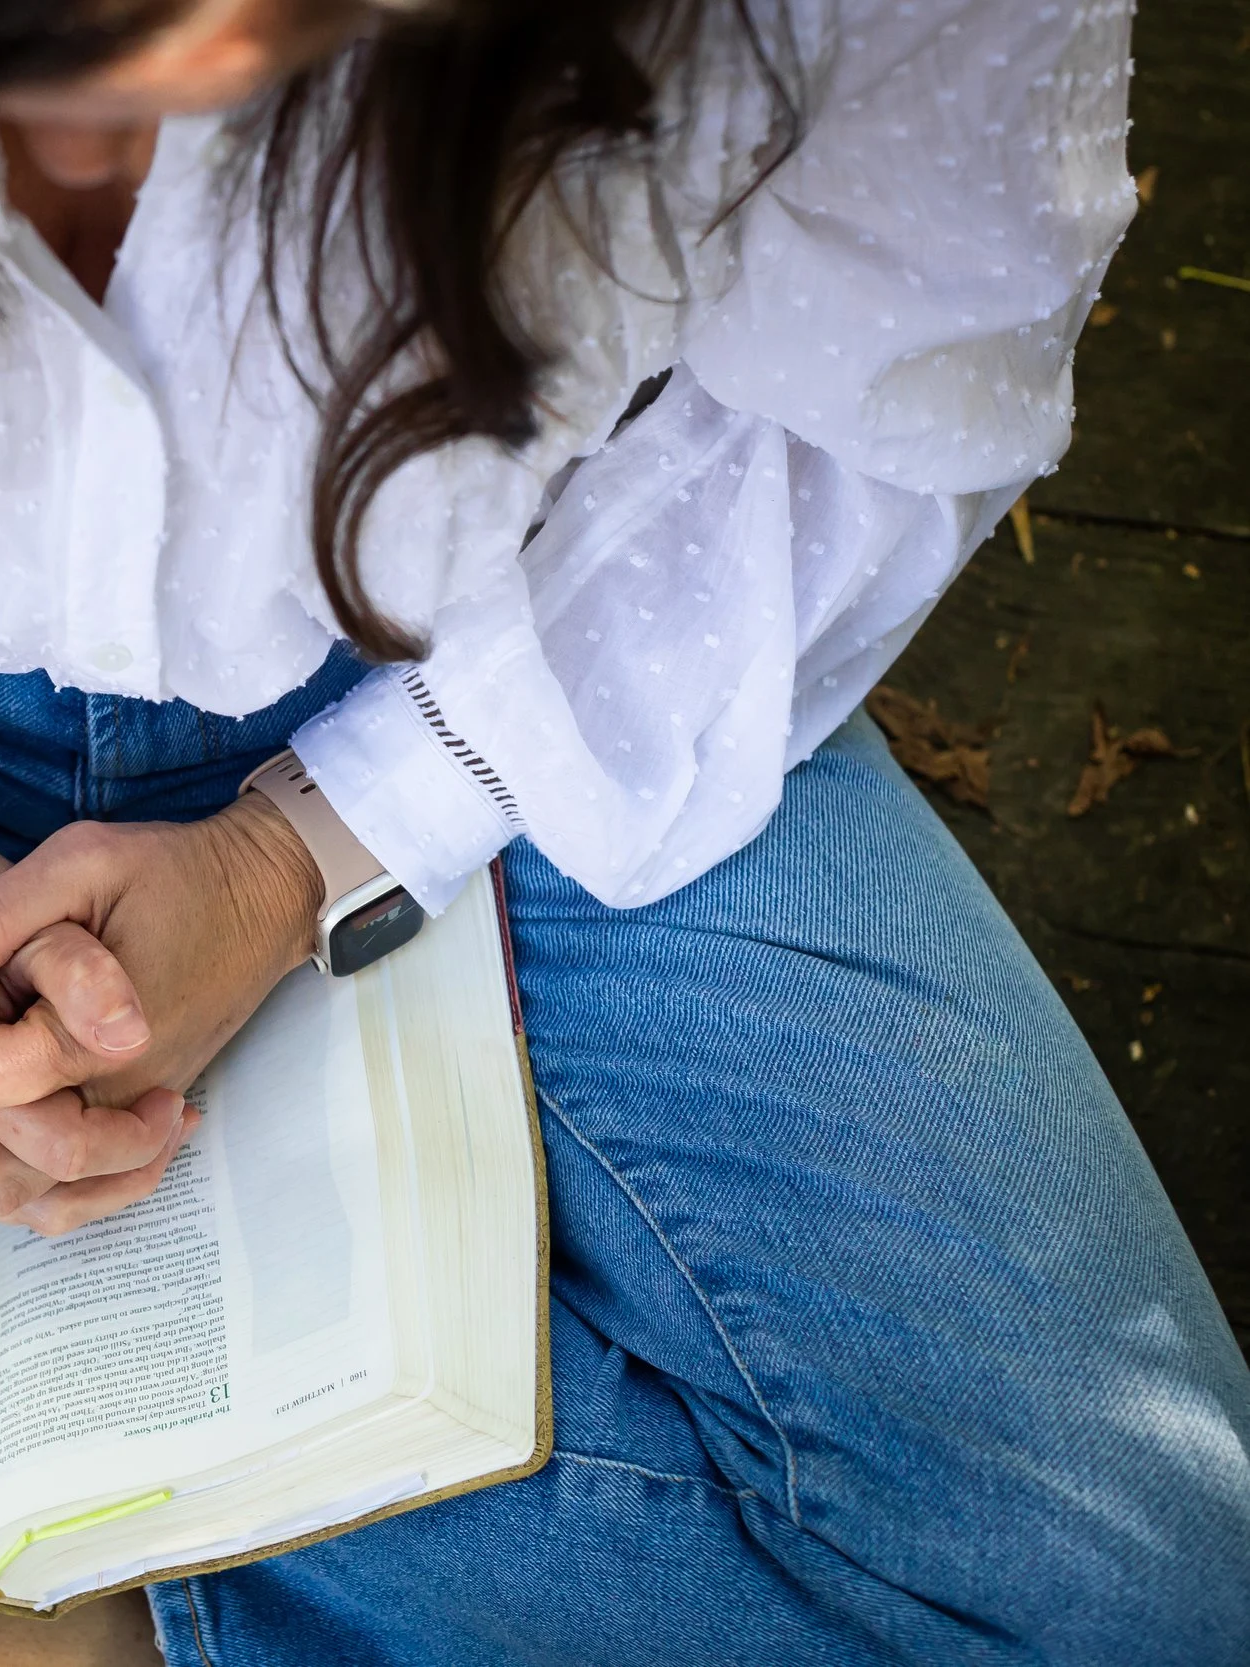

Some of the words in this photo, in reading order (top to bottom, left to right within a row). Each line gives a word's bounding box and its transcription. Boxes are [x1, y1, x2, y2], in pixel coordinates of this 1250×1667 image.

[202, 1249, 220, 1259] they
[165, 1259, 185, 1269] have
[186, 1255, 201, 1266] will
[206, 1258, 220, 1267] has
[162, 1268, 184, 1280] given
[185, 1263, 205, 1274] been
[102, 1284, 116, 1293] not
[117, 1281, 131, 1290] but
[153, 1296, 189, 1310] disciples
[202, 1296, 223, 1307] them
[129, 1306, 152, 1315] came
[130, 1325, 150, 1334] sixty
[94, 1332, 118, 1343] thirty
[189, 1348, 214, 1360] where
[215, 1353, 228, 1364] fell
[151, 1361, 165, 1370] not
[166, 1357, 181, 1368] did
[191, 1358, 214, 1370] along
[129, 1364, 149, 1374] have
[176, 1365, 190, 1374] the
[104, 1369, 128, 1381] much
[134, 1374, 151, 1384] and
[218, 1372, 229, 1383] all
[350, 1370, 368, 1382] 1160
[96, 1381, 118, 1392] birds
[119, 1378, 133, 1386] the
[175, 1379, 203, 1394] people
[204, 1376, 218, 1386] the
[72, 1386, 95, 1397] came
[151, 1388, 174, 1401] stood
[176, 1390, 206, 1404] crowds
[210, 1383, 230, 1403] 13
[290, 1383, 335, 1409] MATTHEW
[42, 1397, 55, 1406] ate
[56, 1392, 72, 1404] and
[123, 1396, 137, 1406] the
[137, 1397, 175, 1414] gathered
[165, 1405, 187, 1416] same
[188, 1400, 206, 1411] That
[215, 1404, 230, 1414] The
[276, 1403, 290, 1415] 13:1
[86, 1414, 104, 1424] him
[105, 1407, 136, 1421] around
[125, 1413, 148, 1424] Jesus
[148, 1411, 164, 1420] day
[179, 1410, 213, 1426] Parable
[56, 1423, 67, 1431] he
[67, 1418, 85, 1429] that
[90, 1424, 104, 1433] out
[104, 1419, 125, 1430] went
[153, 1422, 168, 1431] the
[169, 1420, 178, 1430] of
[42, 1425, 55, 1436] got
[66, 1430, 80, 1438] the
[81, 1427, 89, 1437] of
[124, 1426, 152, 1437] Sower
[42, 1433, 66, 1445] house
